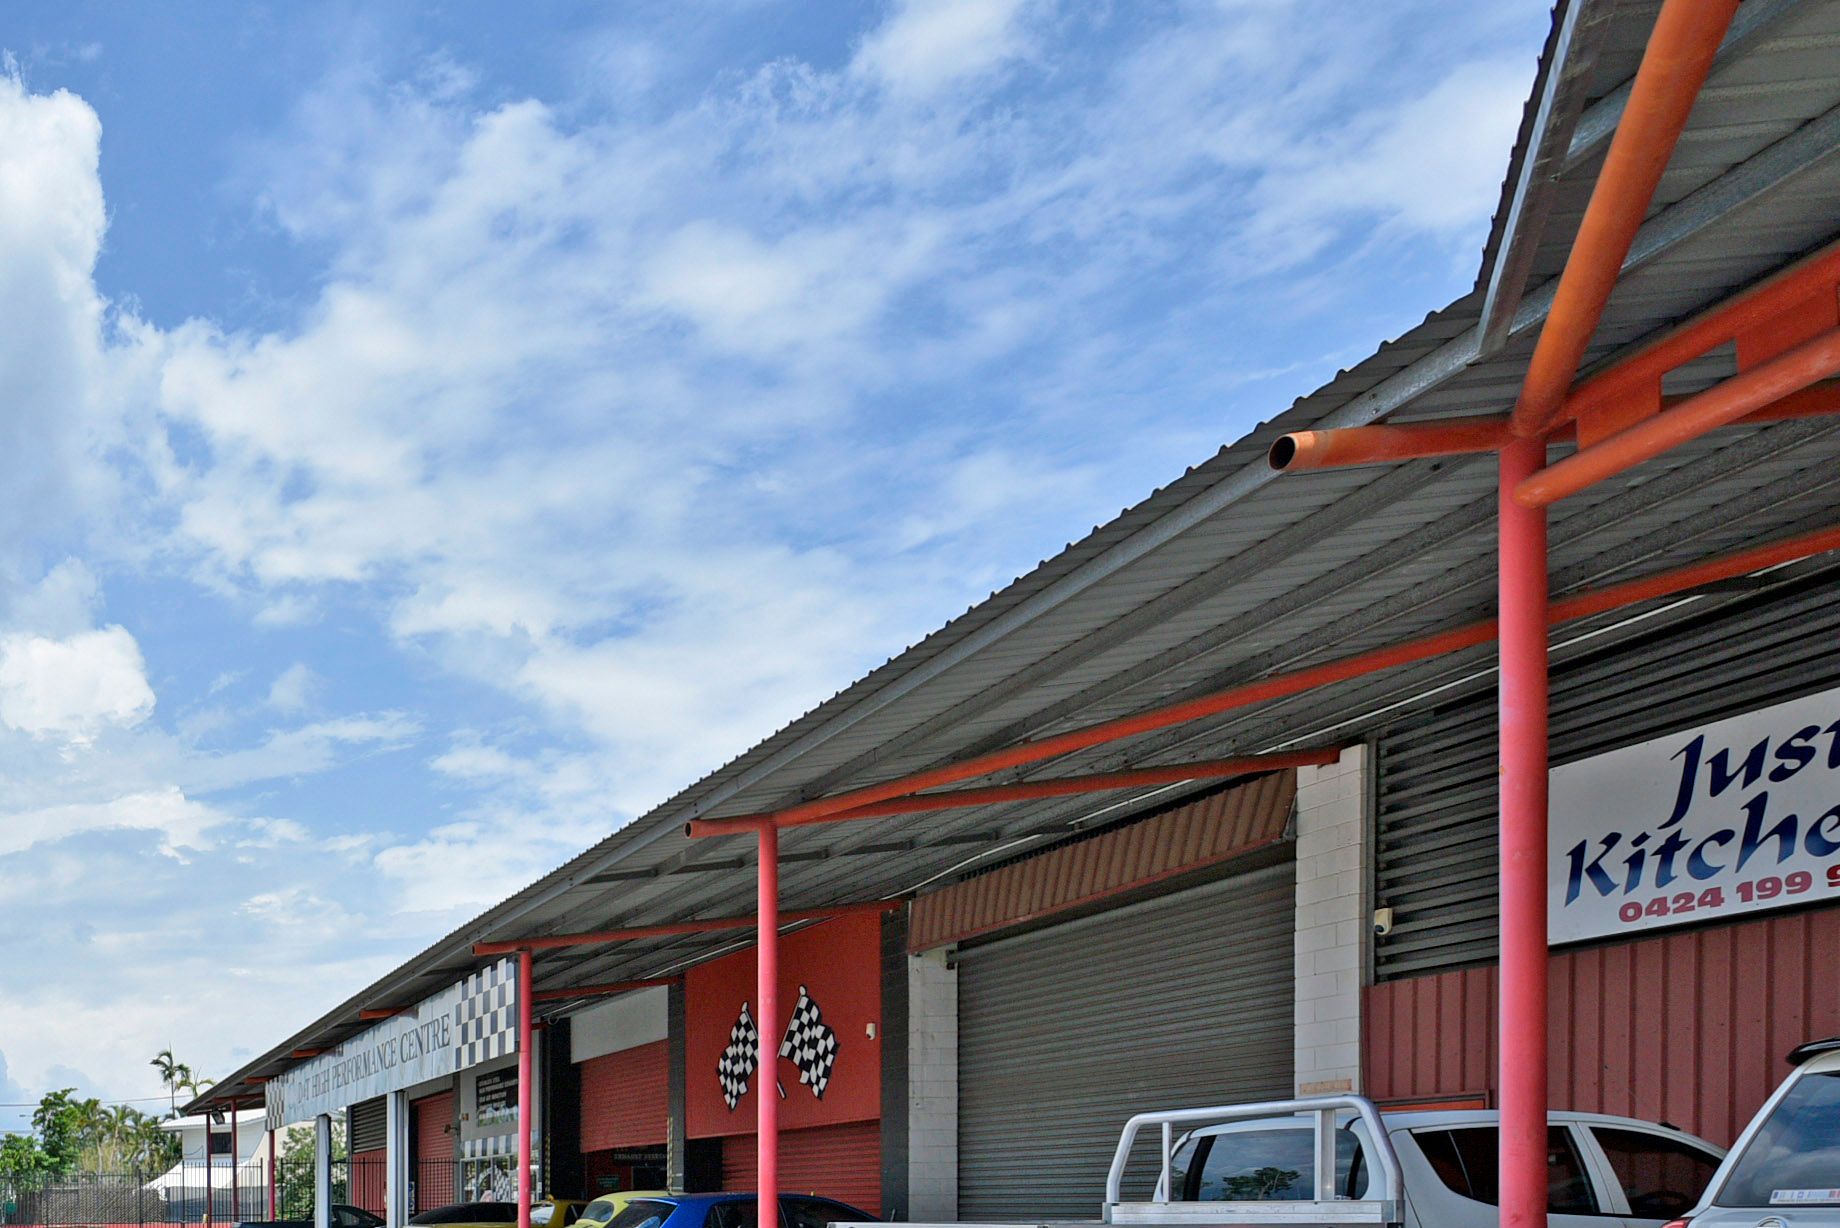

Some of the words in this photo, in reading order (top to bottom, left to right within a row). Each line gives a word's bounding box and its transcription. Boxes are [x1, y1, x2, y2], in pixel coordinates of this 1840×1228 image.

[1618, 887, 1725, 923] 0424
[1736, 870, 1812, 902] 199
[312, 1068, 330, 1098] HIGH
[332, 1037, 397, 1091] PERFORMANCE
[400, 1013, 451, 1064] CENTRE
